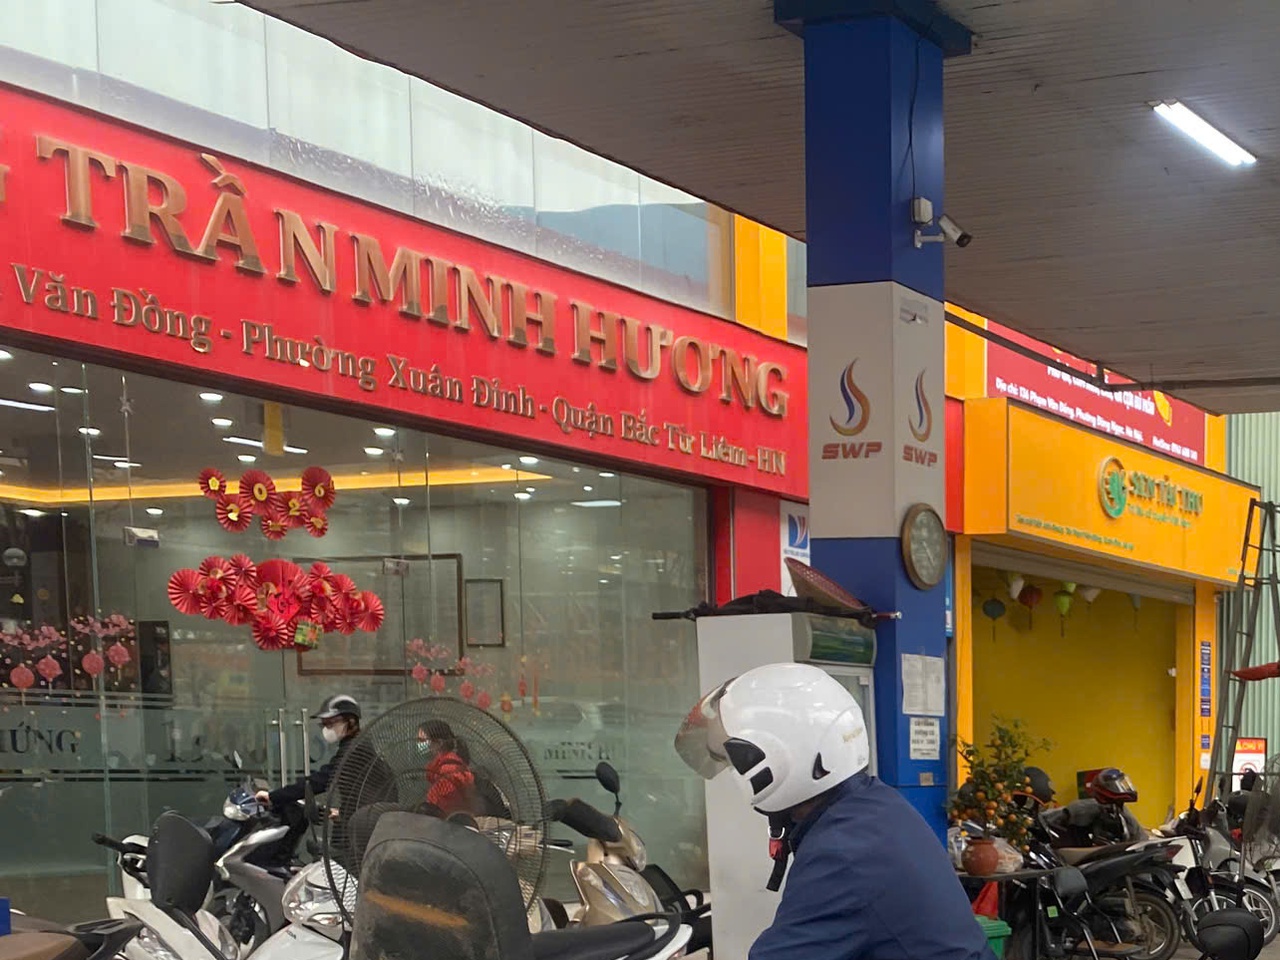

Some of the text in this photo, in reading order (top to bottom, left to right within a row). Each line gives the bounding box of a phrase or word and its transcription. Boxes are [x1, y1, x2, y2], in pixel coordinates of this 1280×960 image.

[35, 135, 790, 418] TRẦN MINH HƯƠNG
[11, 262, 99, 319] Văn
[110, 287, 212, 353] Đồng
[240, 318, 377, 391] Phường
[387, 354, 464, 402] Xuân
[552, 396, 614, 438] Quận
[821, 441, 883, 460] SWP
[902, 444, 938, 467] SWP
